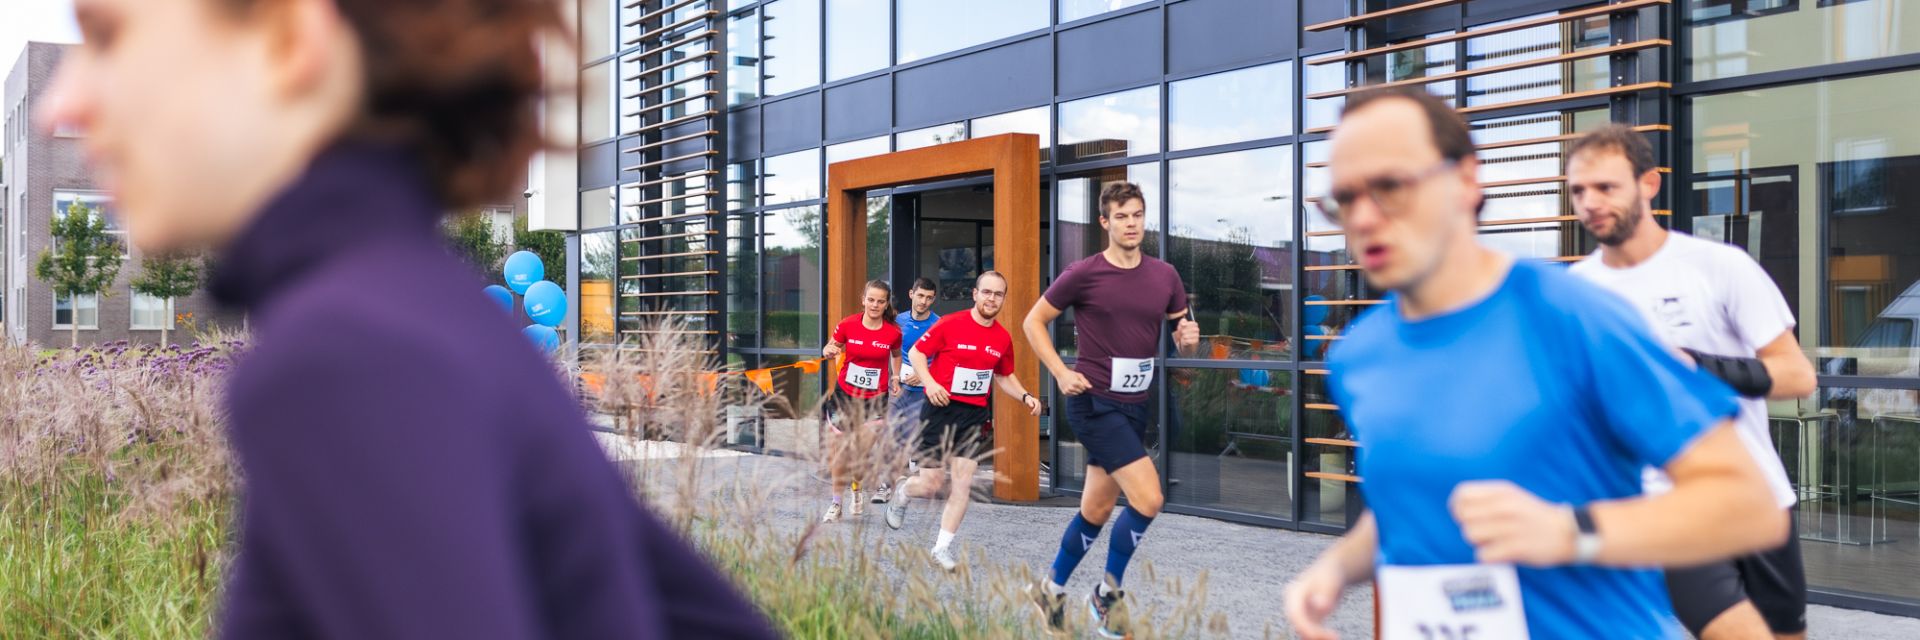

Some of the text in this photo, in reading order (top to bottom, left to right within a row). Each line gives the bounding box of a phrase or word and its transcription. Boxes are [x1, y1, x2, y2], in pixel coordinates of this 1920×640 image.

[853, 374, 872, 386] 193
[962, 380, 983, 391] 192
[1122, 374, 1146, 388] 227
